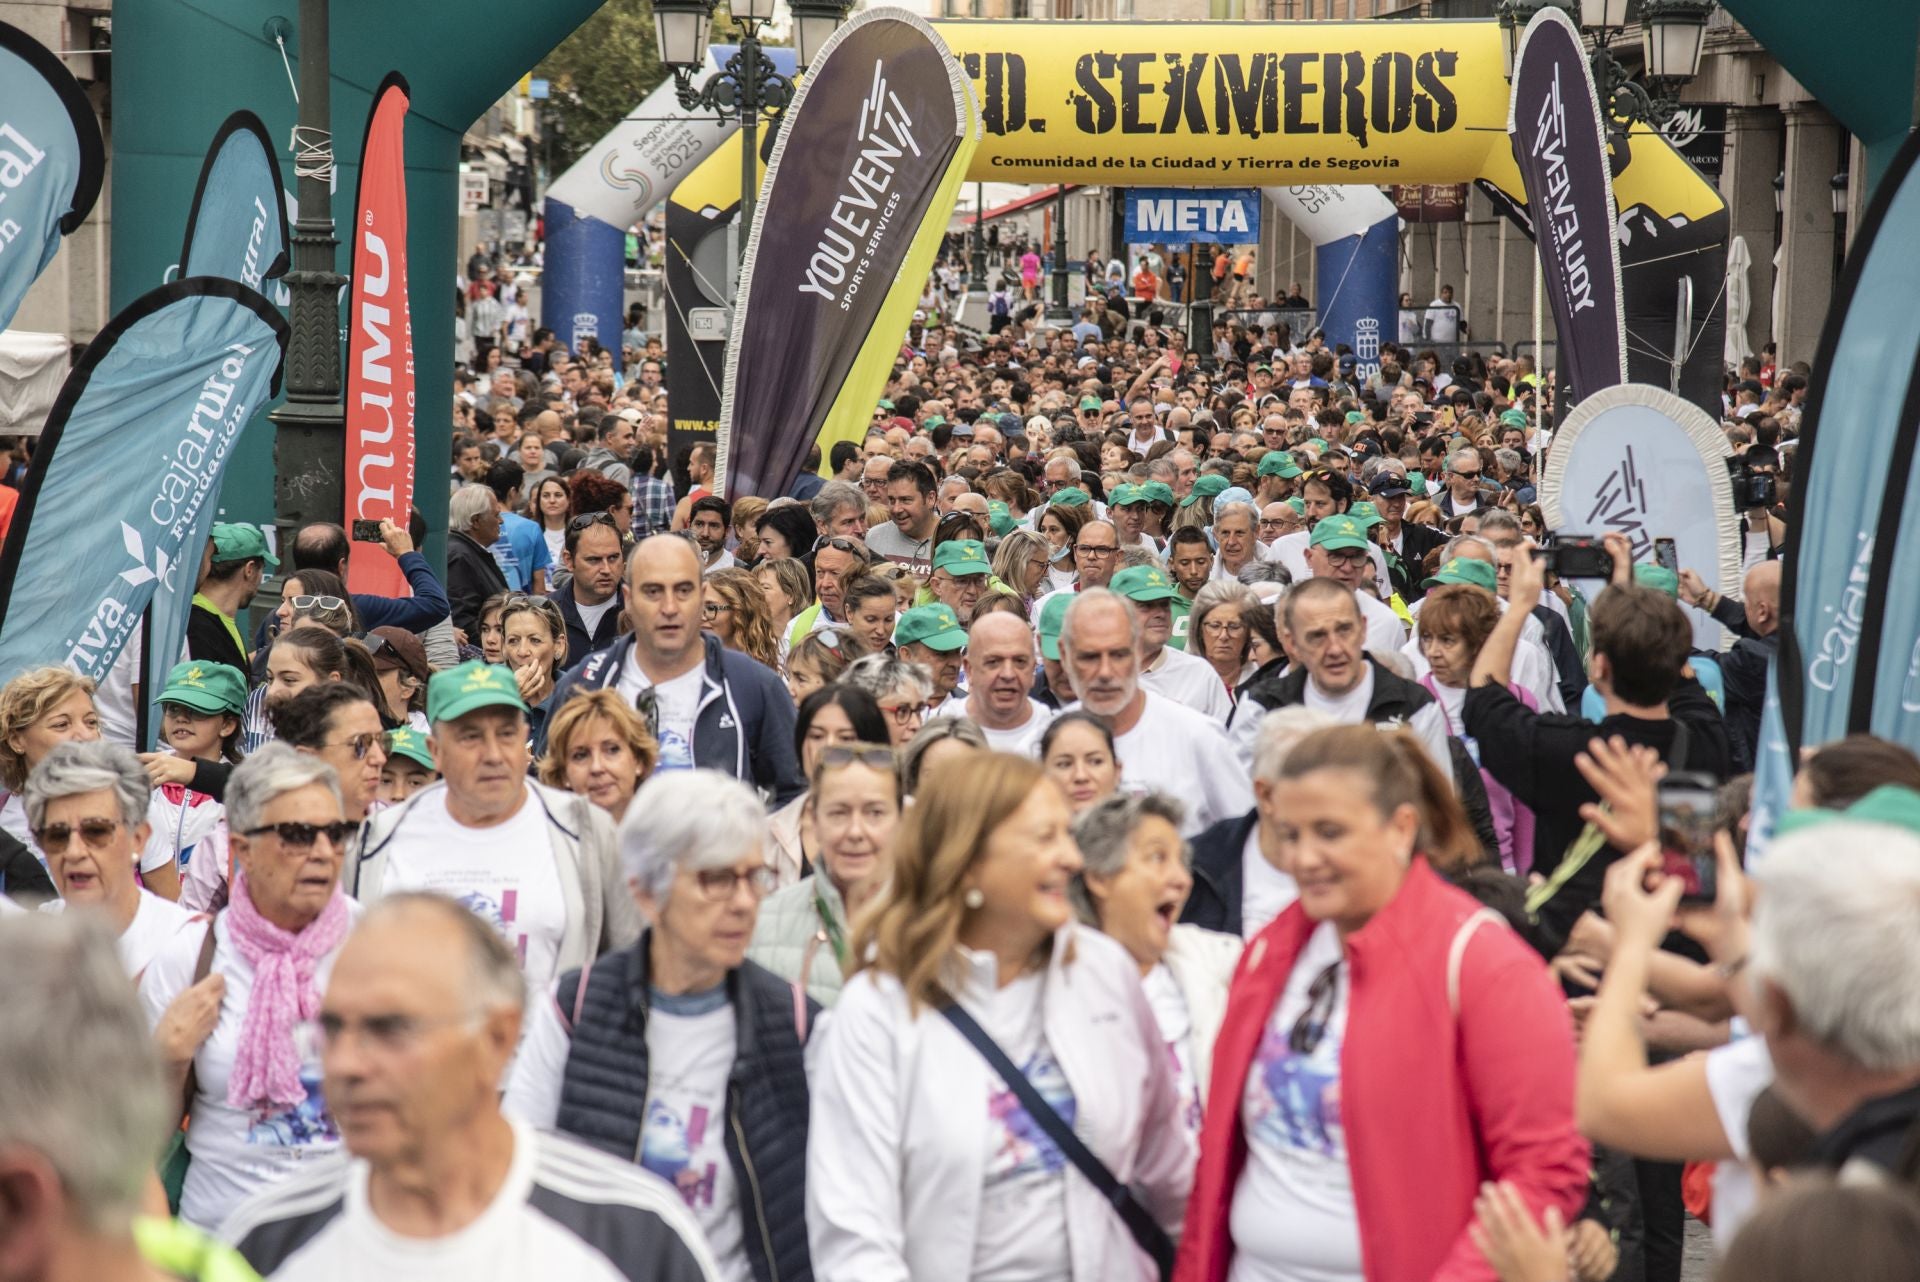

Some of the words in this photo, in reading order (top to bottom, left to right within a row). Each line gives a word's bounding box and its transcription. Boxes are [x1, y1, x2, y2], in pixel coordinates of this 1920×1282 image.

[1070, 49, 1459, 148] SEXMEROS
[633, 112, 677, 151] Segovia
[656, 134, 704, 180] 2025
[991, 155, 1097, 168] Comunidad
[1102, 155, 1125, 168] de
[1130, 155, 1147, 168] la
[1151, 155, 1216, 169] Ciudad
[1222, 158, 1232, 170] y
[1237, 156, 1293, 169] Tierra
[1298, 156, 1322, 169] de
[1326, 155, 1400, 171] Segovia
[1137, 199, 1249, 232] META
[840, 258, 870, 311] SPORTS
[865, 191, 901, 257] SERVICES
[170, 402, 246, 543] Fundación
